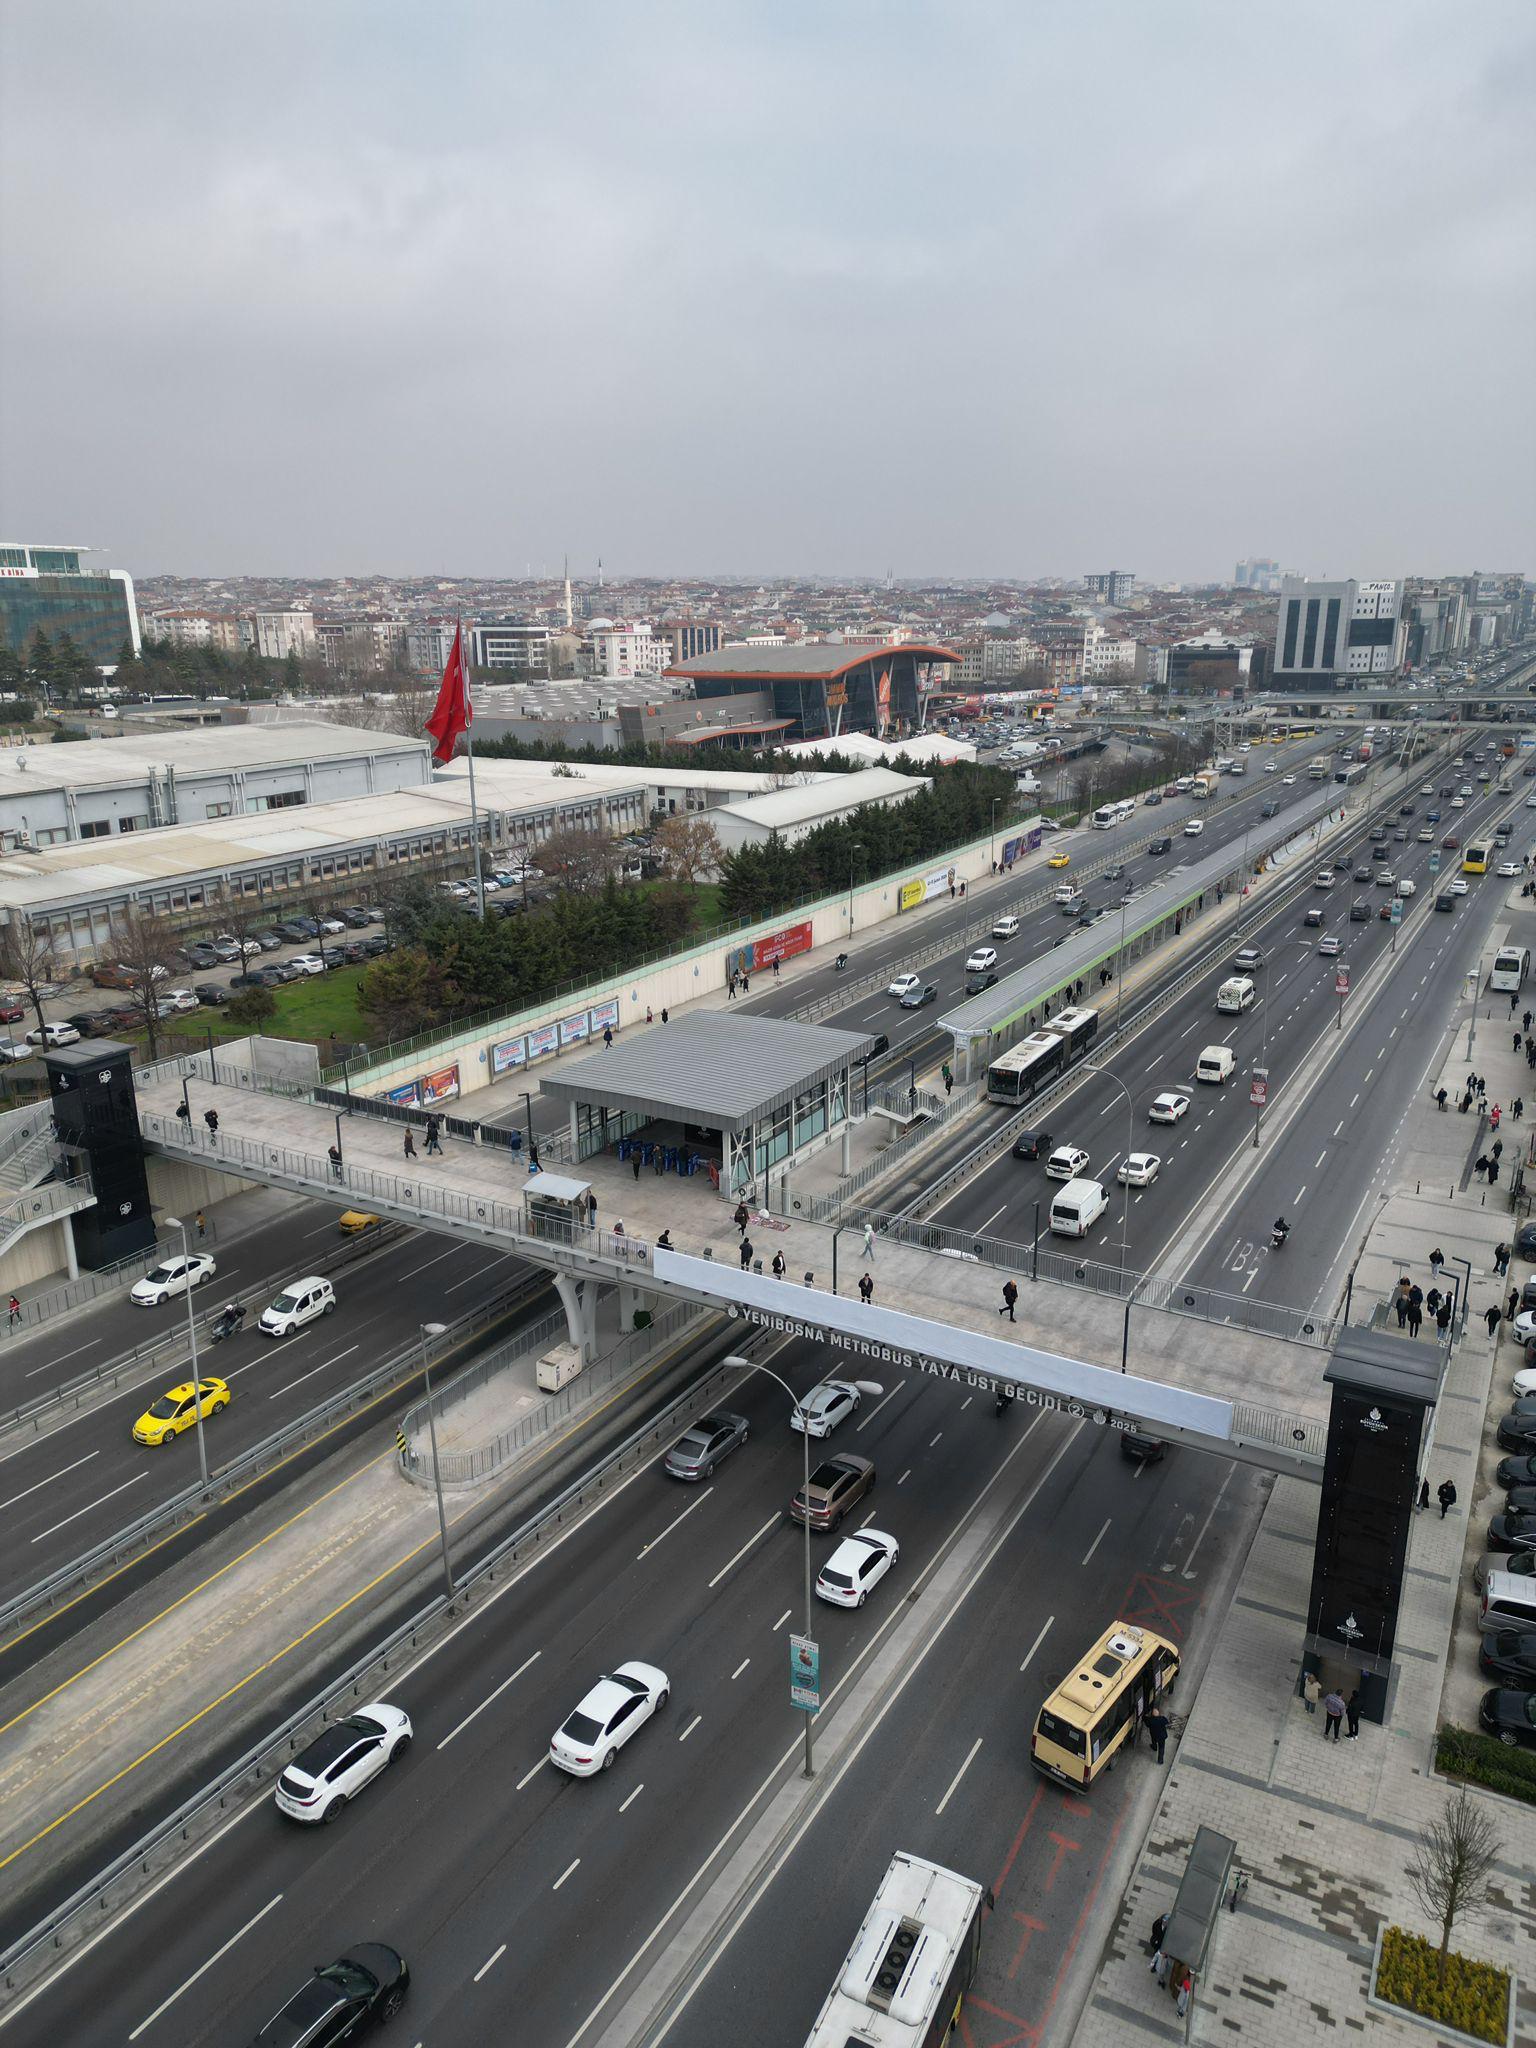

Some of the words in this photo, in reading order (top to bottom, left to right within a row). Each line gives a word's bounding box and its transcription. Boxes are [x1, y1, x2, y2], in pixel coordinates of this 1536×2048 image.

[743, 1308, 825, 1343] YENİBOSNA
[830, 1333, 912, 1368] METROBÜS
[918, 1358, 960, 1381] YAYA
[967, 1372, 999, 1392] ÜST
[1004, 1384, 1061, 1412] GEÇİDİ
[1110, 1419, 1137, 1434] 2025
